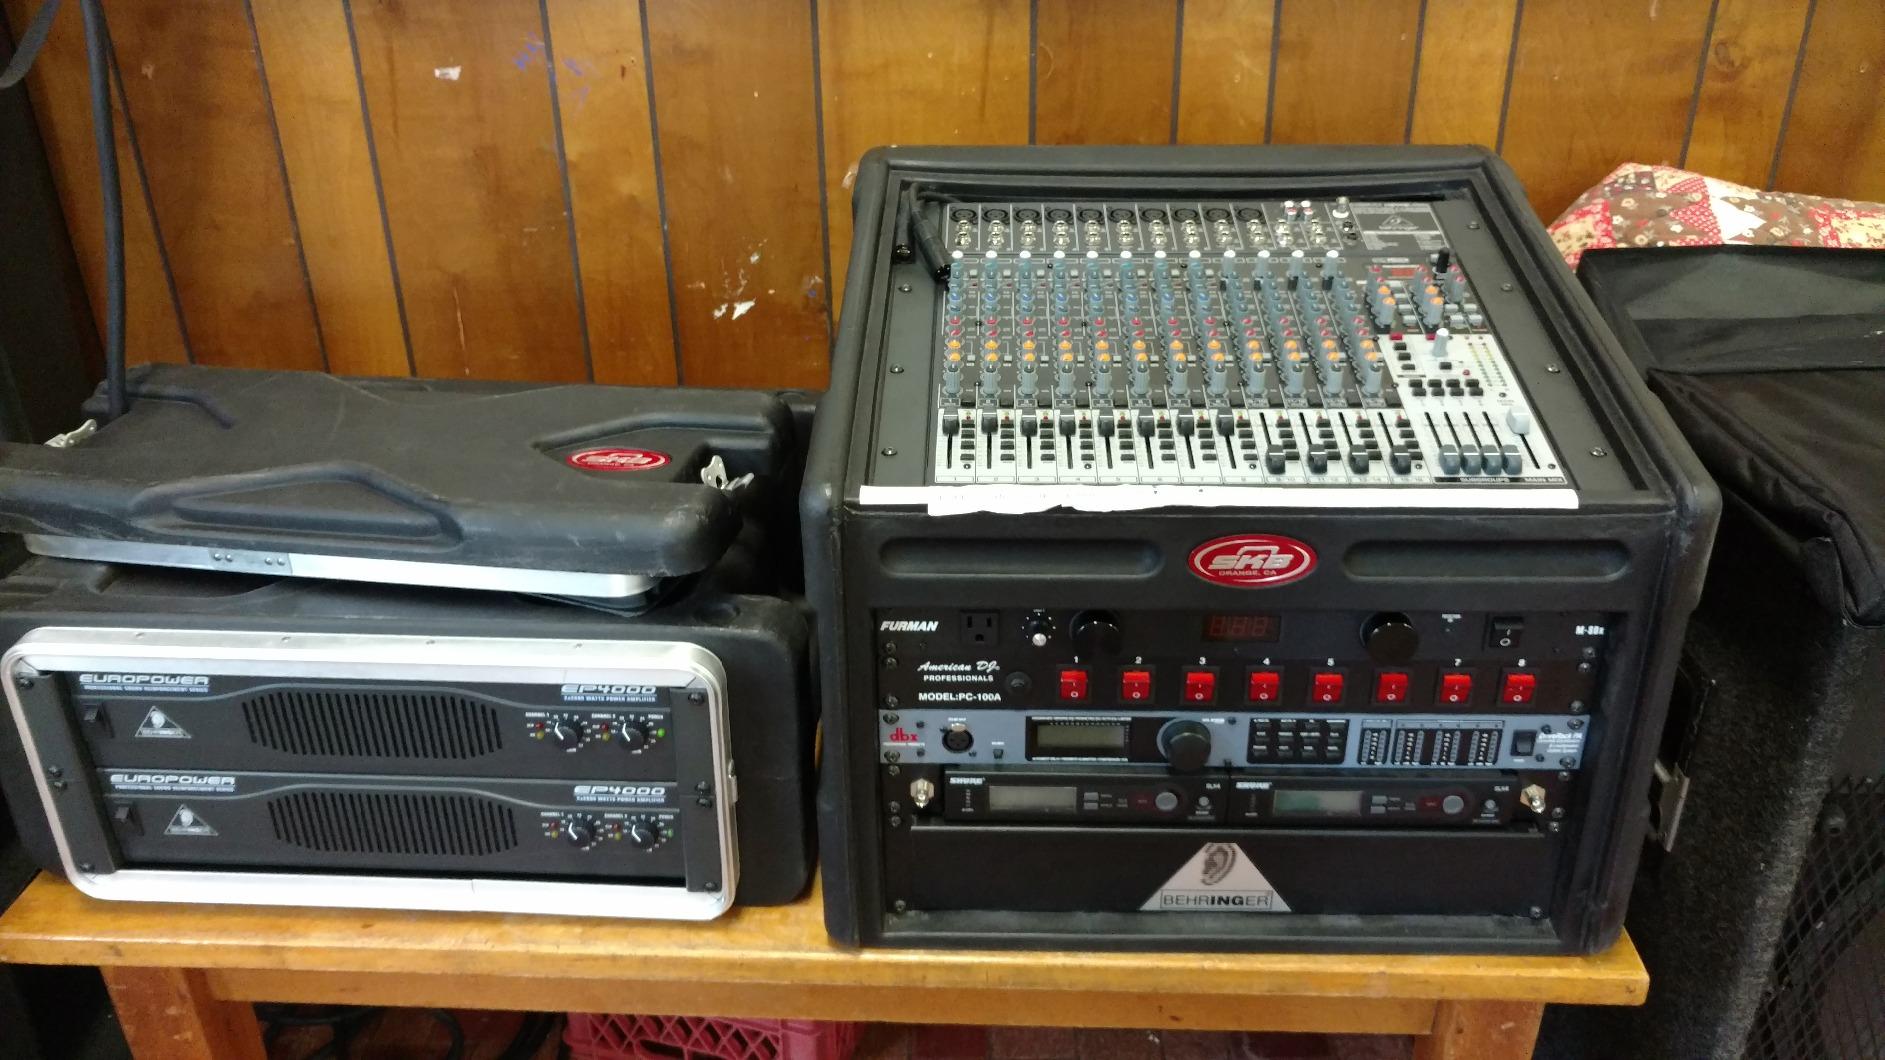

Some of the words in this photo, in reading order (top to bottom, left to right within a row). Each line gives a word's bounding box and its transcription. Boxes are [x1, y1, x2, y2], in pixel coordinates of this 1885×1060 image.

[1207, 545, 1294, 570] SKB
[879, 620, 940, 632] FURMAN
[1073, 655, 1079, 664] 1
[1135, 656, 1142, 664] 2
[1199, 656, 1206, 665] 3
[1263, 657, 1270, 666] 4
[1454, 657, 1462, 667] 7
[916, 660, 973, 672] American
[78, 673, 210, 686] EUROPOWER
[923, 674, 995, 683] PROFESSIONALS
[560, 684, 657, 694] EP4000
[918, 692, 1002, 702] MODEL:PC-100A
[889, 728, 919, 742] dbx
[110, 773, 236, 785] EUROPOWER
[573, 785, 666, 795] EP4000
[1163, 894, 1269, 906] BEHRINGER
